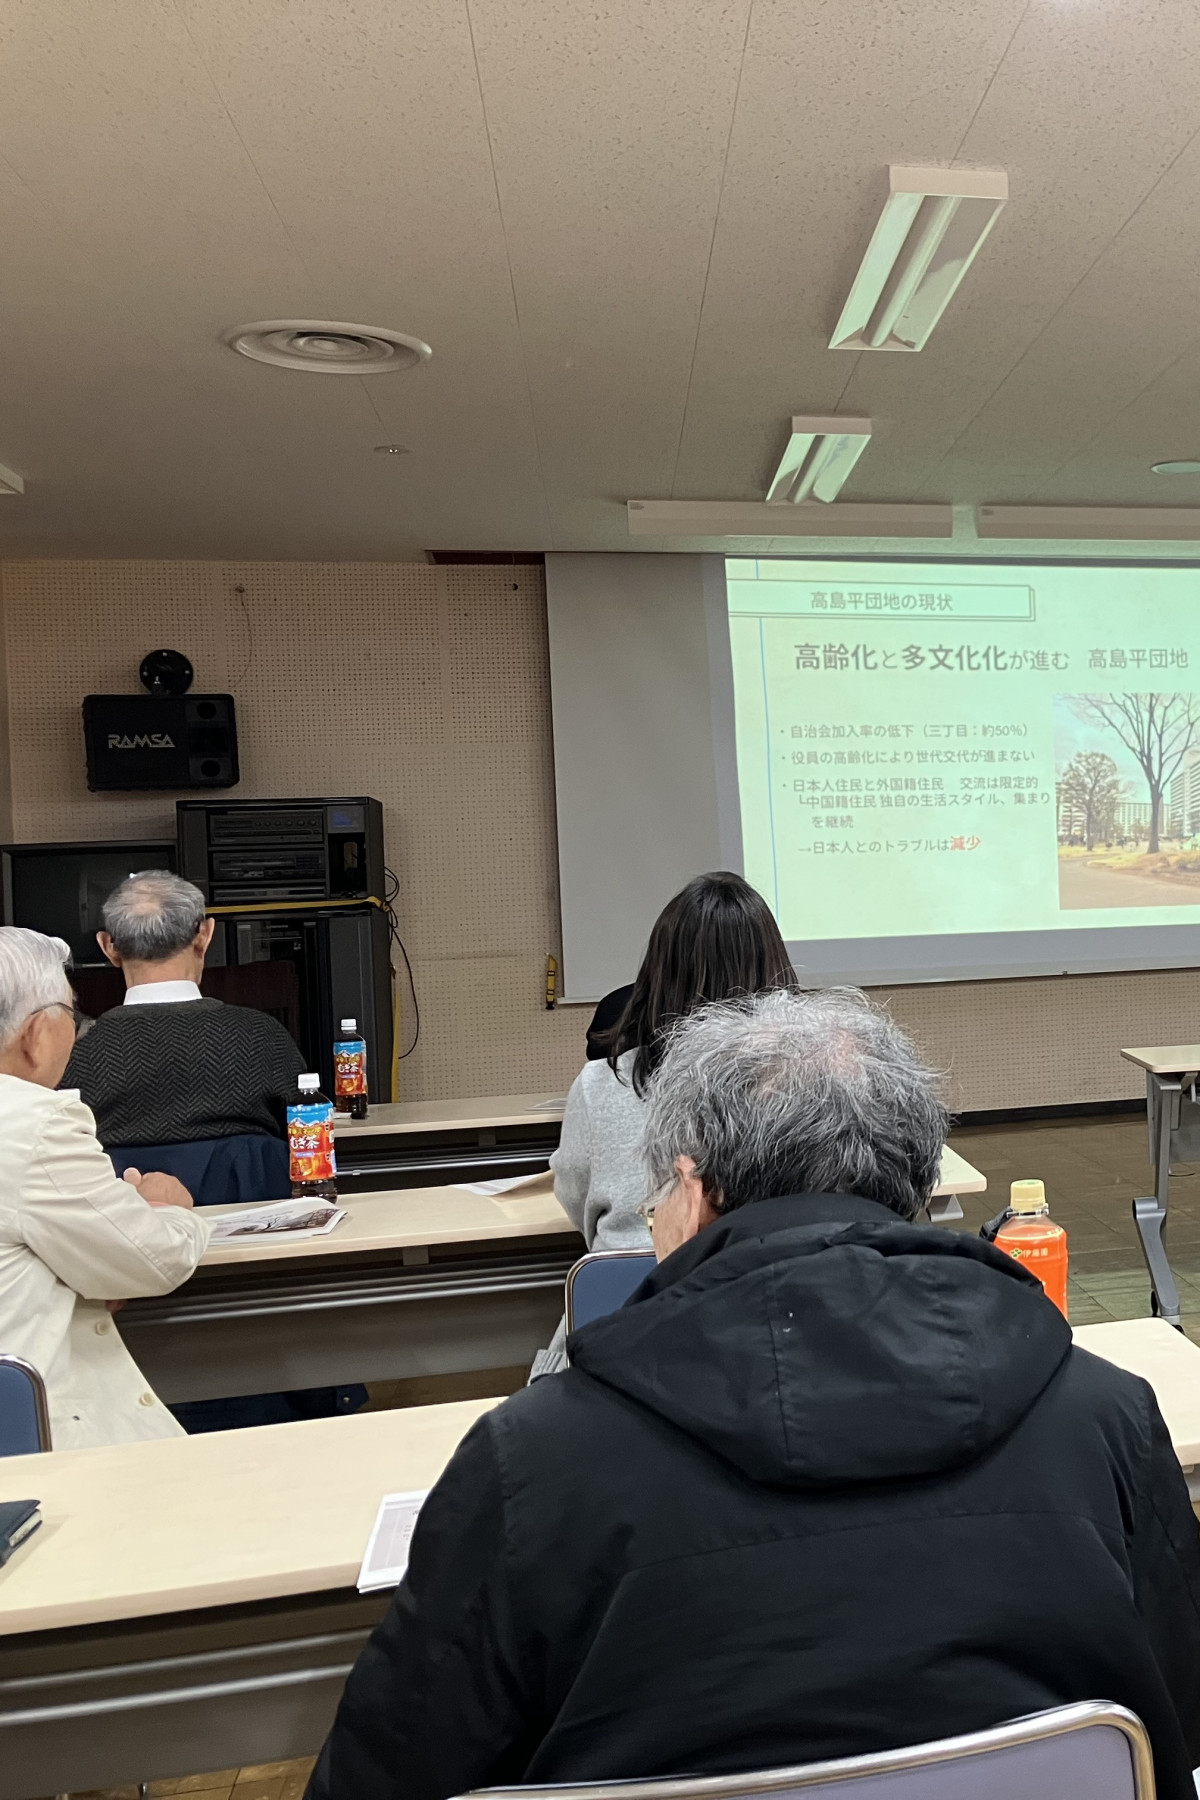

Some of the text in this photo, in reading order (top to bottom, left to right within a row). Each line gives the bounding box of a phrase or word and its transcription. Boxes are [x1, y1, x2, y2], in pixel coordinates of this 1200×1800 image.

[811, 591, 953, 611] 高島平団地の現状
[794, 643, 1189, 671] 高齢化と多文化化が進む 高島平団地
[108, 734, 176, 748] RAMSA
[791, 749, 1036, 765] 役員の高齢化により世代交代が進まない
[811, 815, 854, 829] を継続
[289, 1135, 320, 1149] むぎ茶
